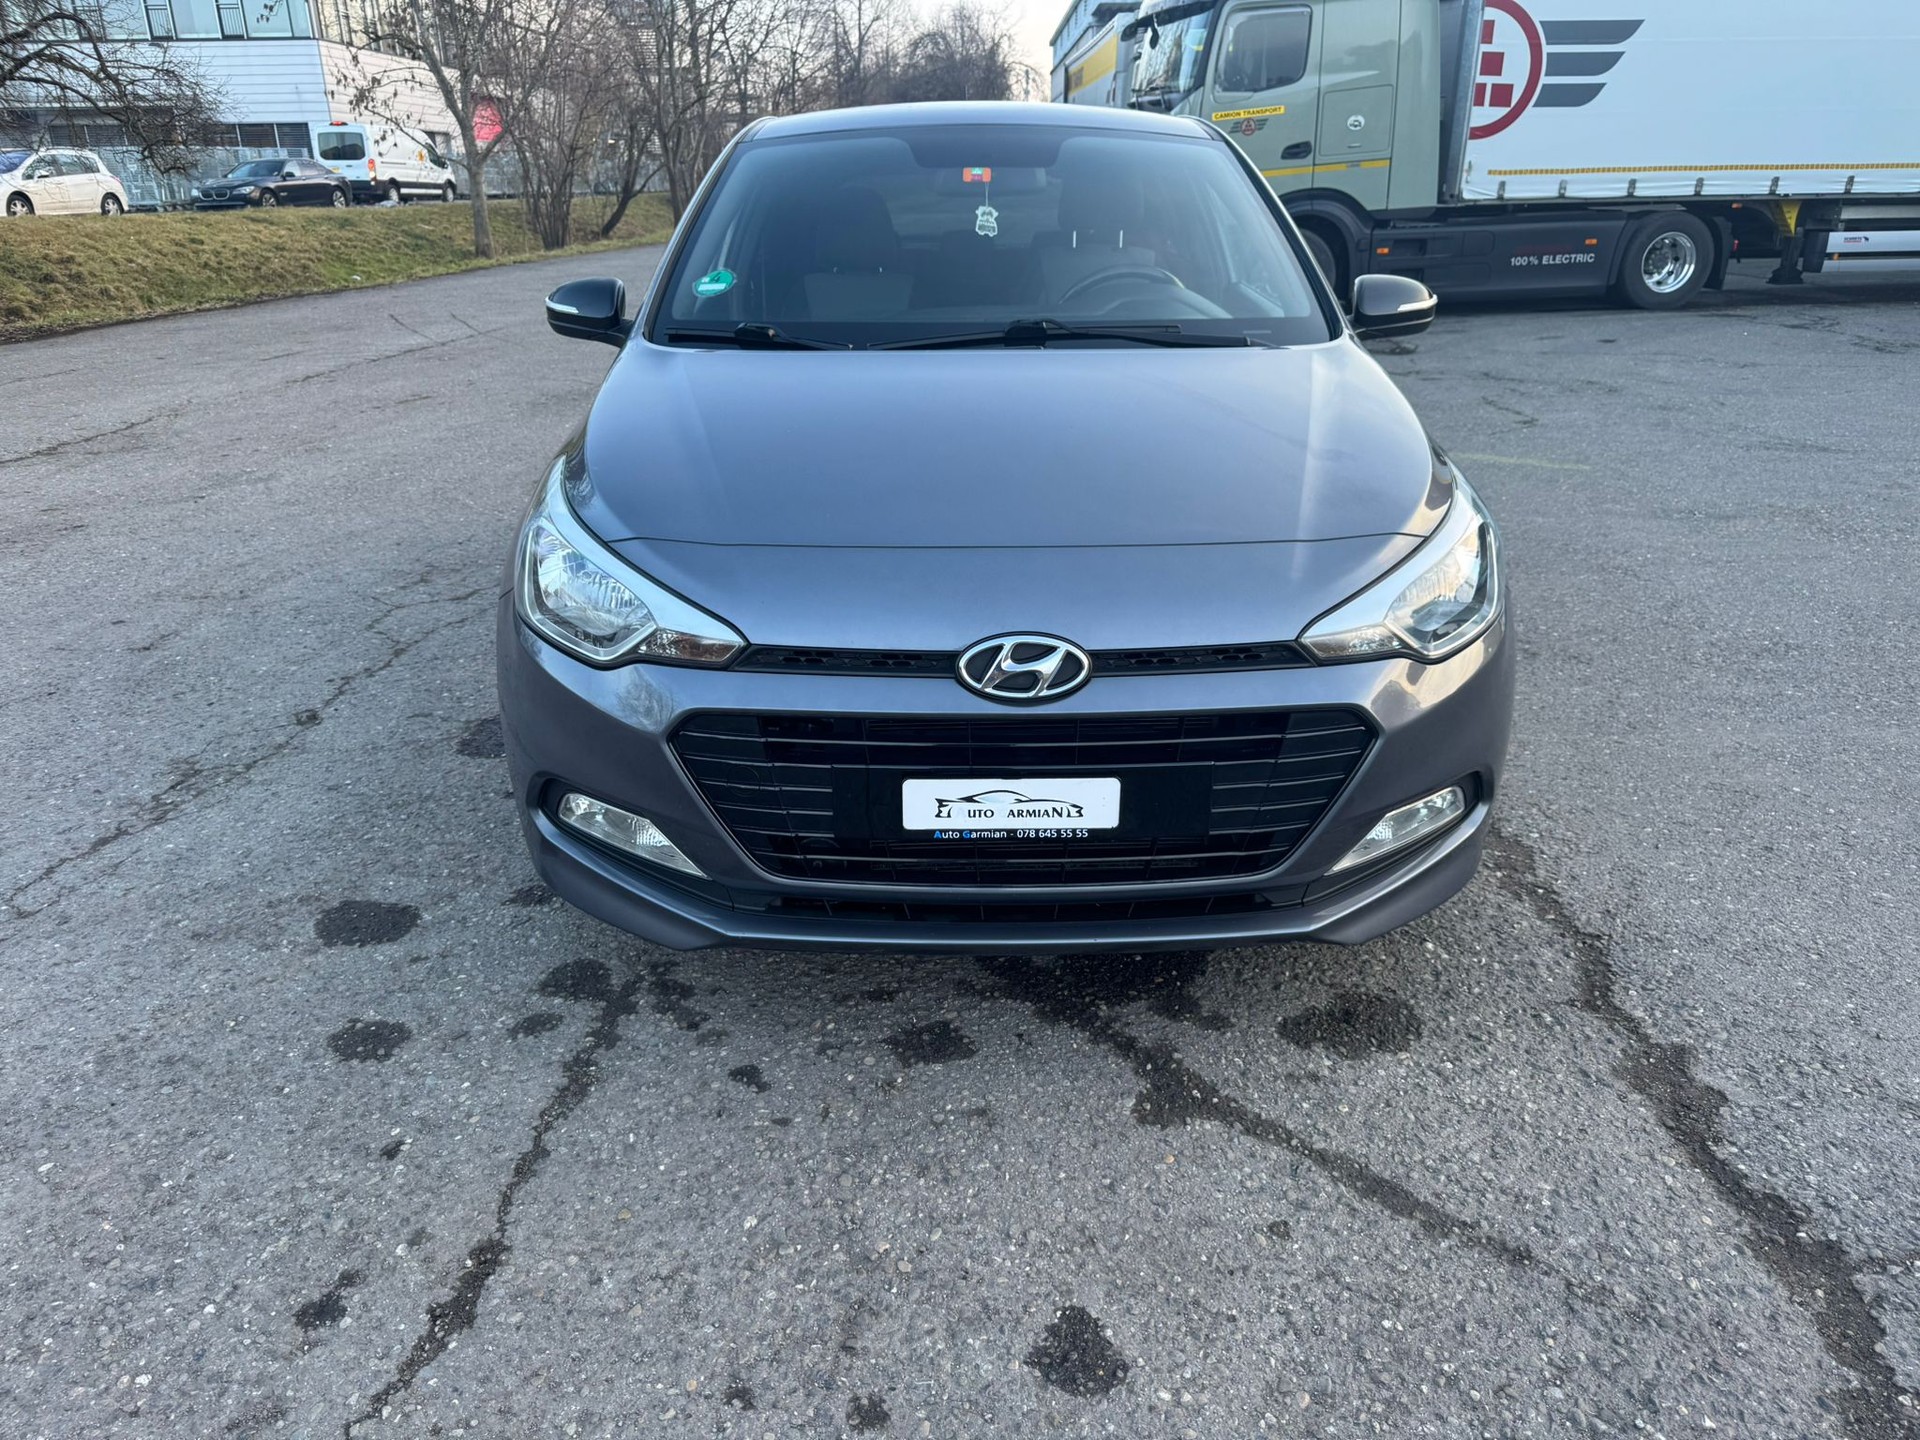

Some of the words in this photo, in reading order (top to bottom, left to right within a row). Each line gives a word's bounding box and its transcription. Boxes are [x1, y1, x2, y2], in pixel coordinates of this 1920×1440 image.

[1214, 110, 1241, 120] CAMION
[1243, 106, 1282, 116] TRANSPORT
[1542, 253, 1595, 265] ELECTRIC
[934, 830, 960, 839] Auto
[962, 829, 1007, 839] Garmian
[1017, 829, 1036, 838] 078
[1038, 829, 1057, 838] 645
[1060, 829, 1073, 838] 55
[1076, 829, 1089, 838] 55
